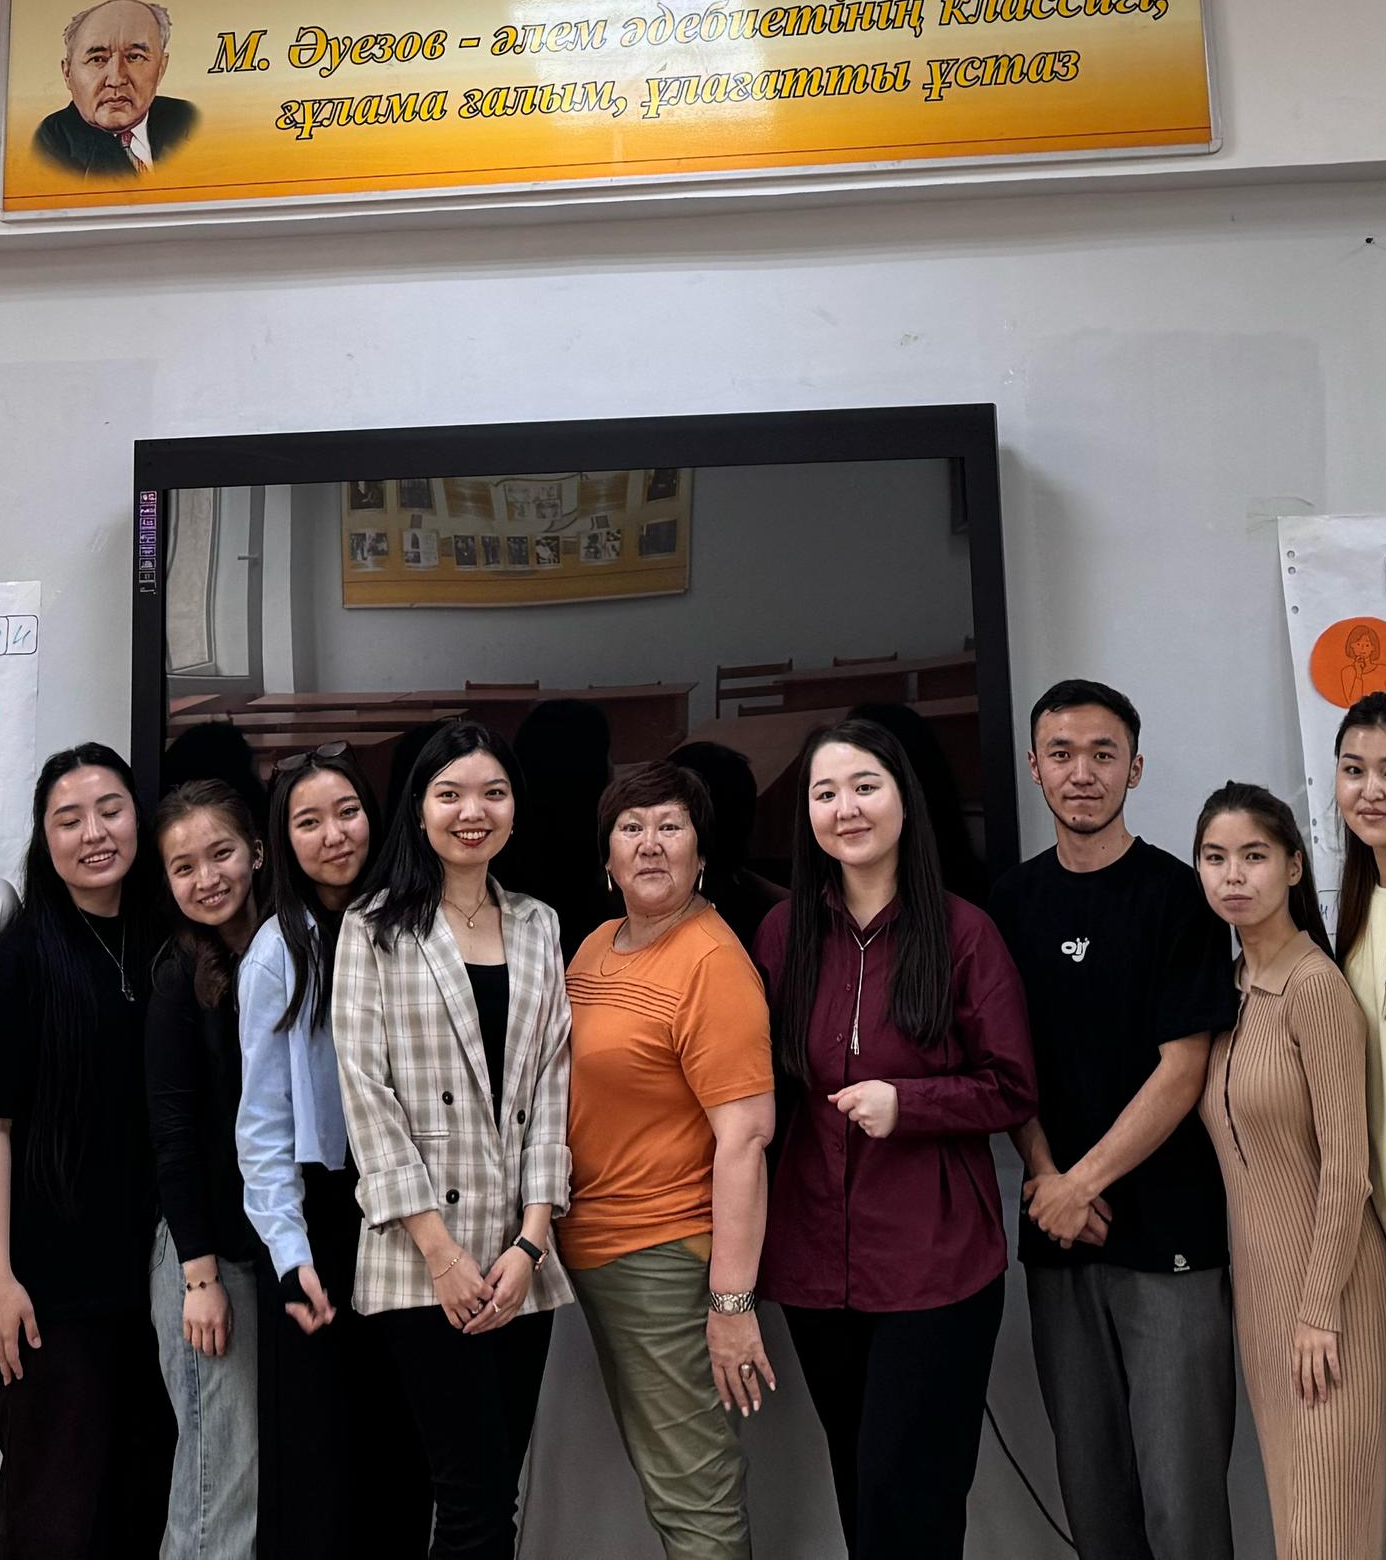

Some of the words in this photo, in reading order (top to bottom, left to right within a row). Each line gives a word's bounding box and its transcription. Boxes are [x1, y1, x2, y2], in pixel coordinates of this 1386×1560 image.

[208, 29, 271, 73] М.
[287, 26, 448, 78] Әуезов
[490, 19, 608, 56] әлем
[274, 90, 449, 141] ғұлама
[458, 80, 629, 119] ғалым,
[640, 60, 912, 120] ұлағатты
[922, 50, 1081, 102] ұстаз
